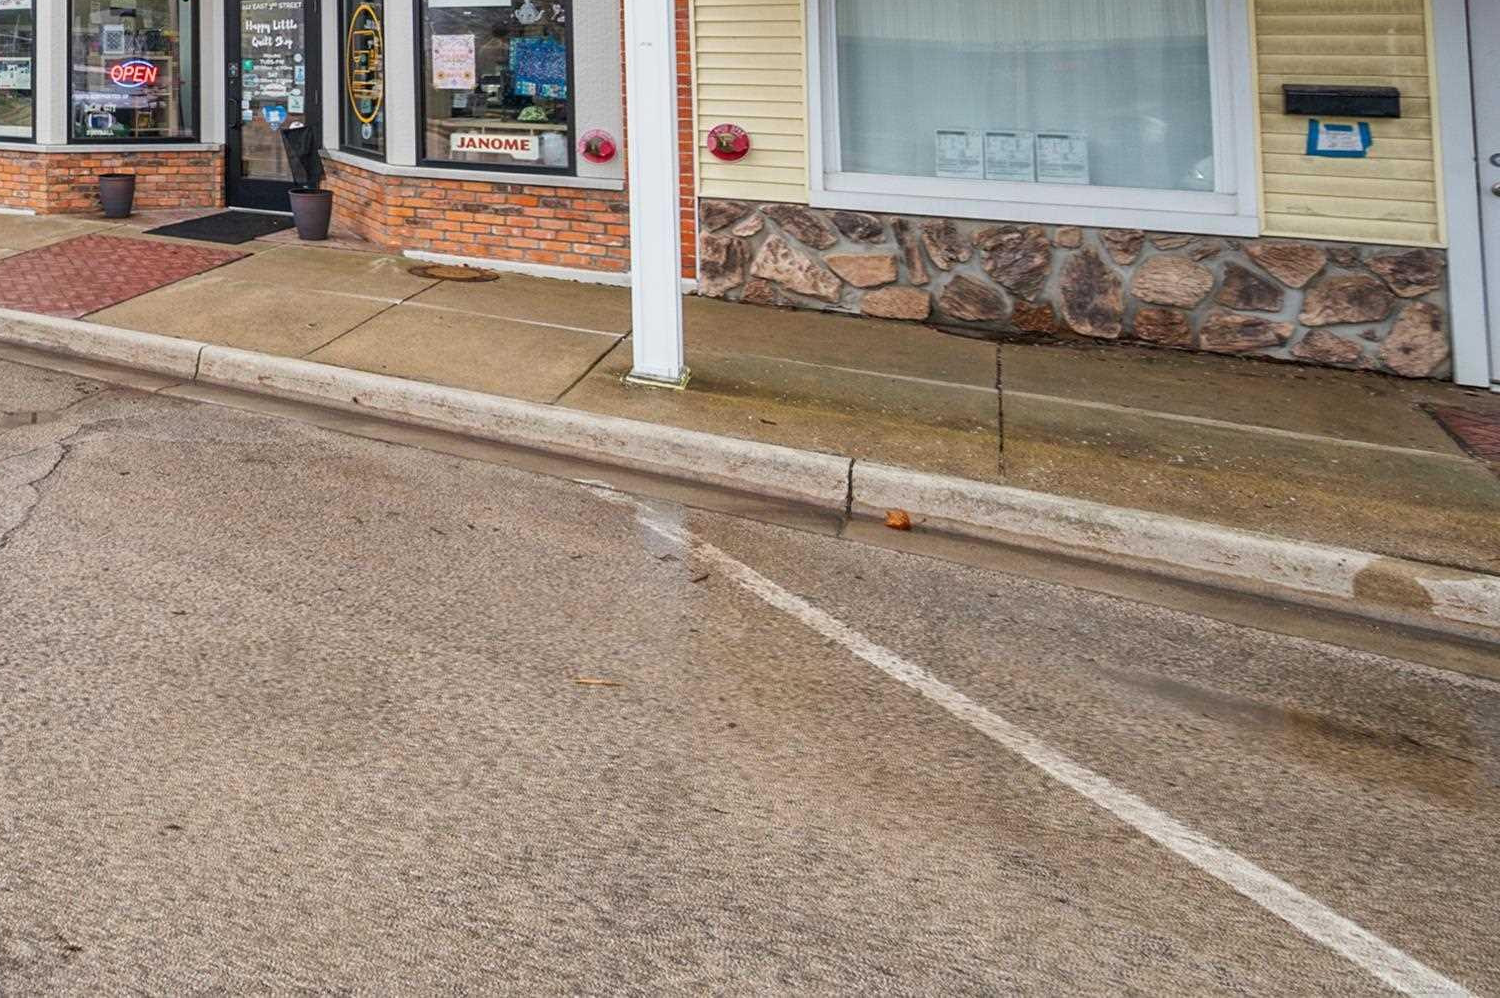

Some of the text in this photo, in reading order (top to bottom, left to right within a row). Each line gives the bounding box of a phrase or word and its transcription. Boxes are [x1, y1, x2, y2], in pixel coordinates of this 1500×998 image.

[278, 1, 303, 9] STREET
[245, 19, 298, 34] Happy Little
[251, 36, 273, 48] Quilt
[110, 65, 158, 83] OPEN
[457, 137, 530, 151] JANOME
